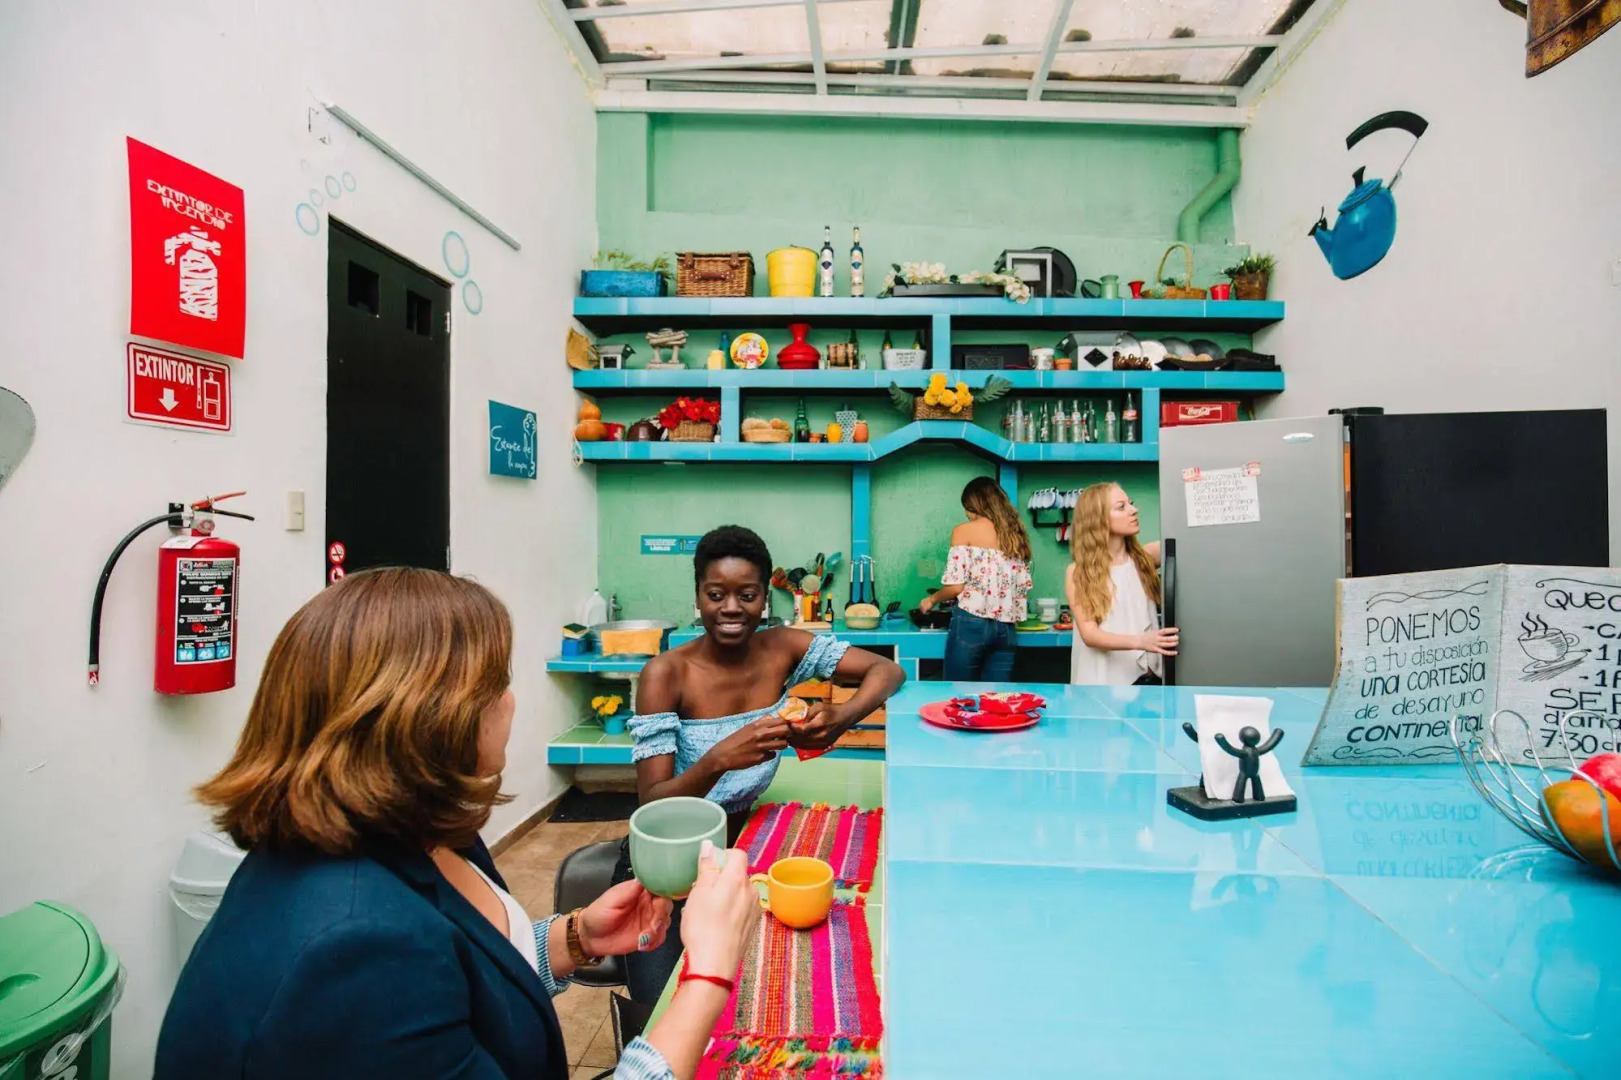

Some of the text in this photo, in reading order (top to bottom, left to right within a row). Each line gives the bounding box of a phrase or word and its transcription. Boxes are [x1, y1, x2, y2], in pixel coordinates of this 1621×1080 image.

[146, 178, 233, 223] EXTINTOR DE
[161, 195, 226, 230] INCENDIO
[135, 352, 195, 386] EXTINTOR
[1366, 605, 1481, 646] PONEMOS
[1365, 636, 1489, 673] a tu disposición
[1361, 674, 1400, 698] una
[1354, 703, 1380, 720] de
[1540, 728, 1598, 754] 7:30
